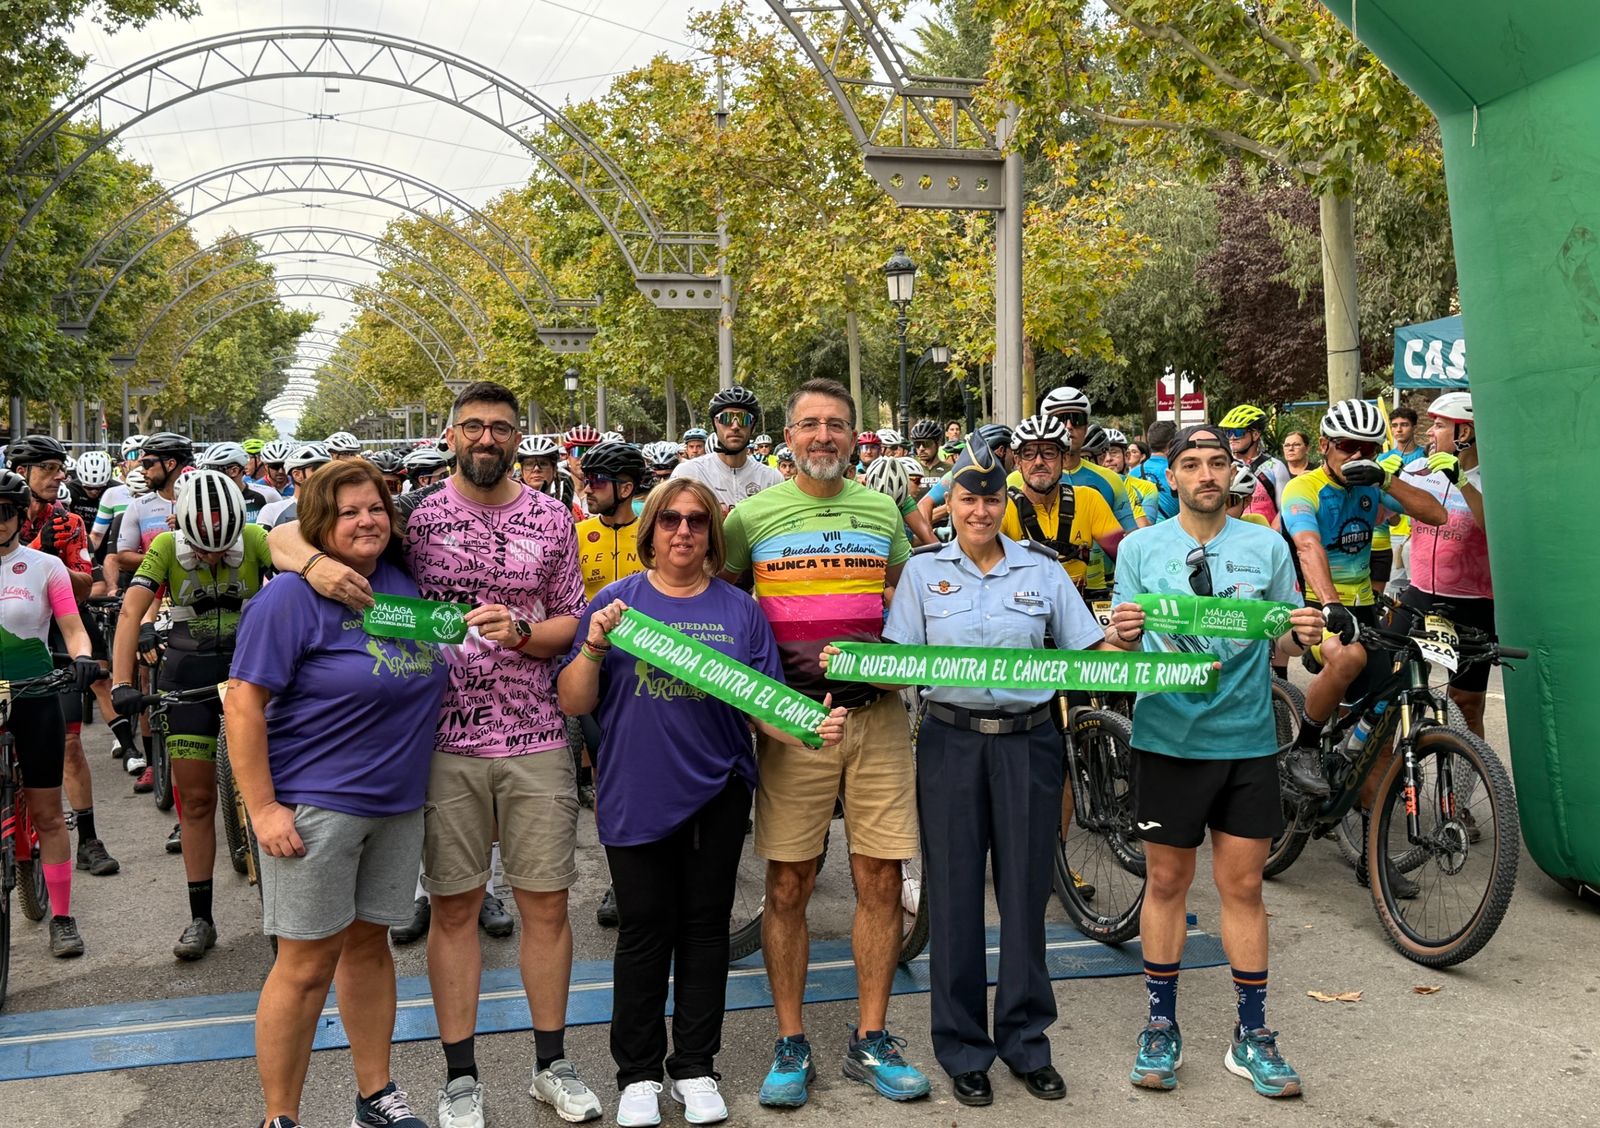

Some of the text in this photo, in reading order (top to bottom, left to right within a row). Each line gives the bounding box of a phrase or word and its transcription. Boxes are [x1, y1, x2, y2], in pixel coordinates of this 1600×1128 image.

[822, 530, 841, 542] VIII
[782, 543, 877, 557] Quedada Solidaria
[767, 559, 817, 573] NUNCA
[821, 559, 841, 568] TE
[373, 603, 413, 615] MÁLAGA
[1204, 607, 1245, 619] MÁLAGA
[370, 610, 416, 624] COMPITE
[1201, 616, 1249, 628] COMPITE
[670, 622, 725, 632] QUEDADA
[691, 632, 735, 645] CÁNCER
[859, 654, 926, 678] QUEDADA
[931, 657, 987, 681] CONTRA
[992, 659, 1008, 682] EL
[1012, 655, 1067, 684] CÁNCER
[1134, 662, 1150, 685] TE
[633, 627, 703, 672] QUEDADA
[700, 658, 758, 701] CONTRA
[754, 685, 777, 710] EL
[774, 696, 829, 733] CÁNCE
[505, 729, 565, 747] INTENTA
